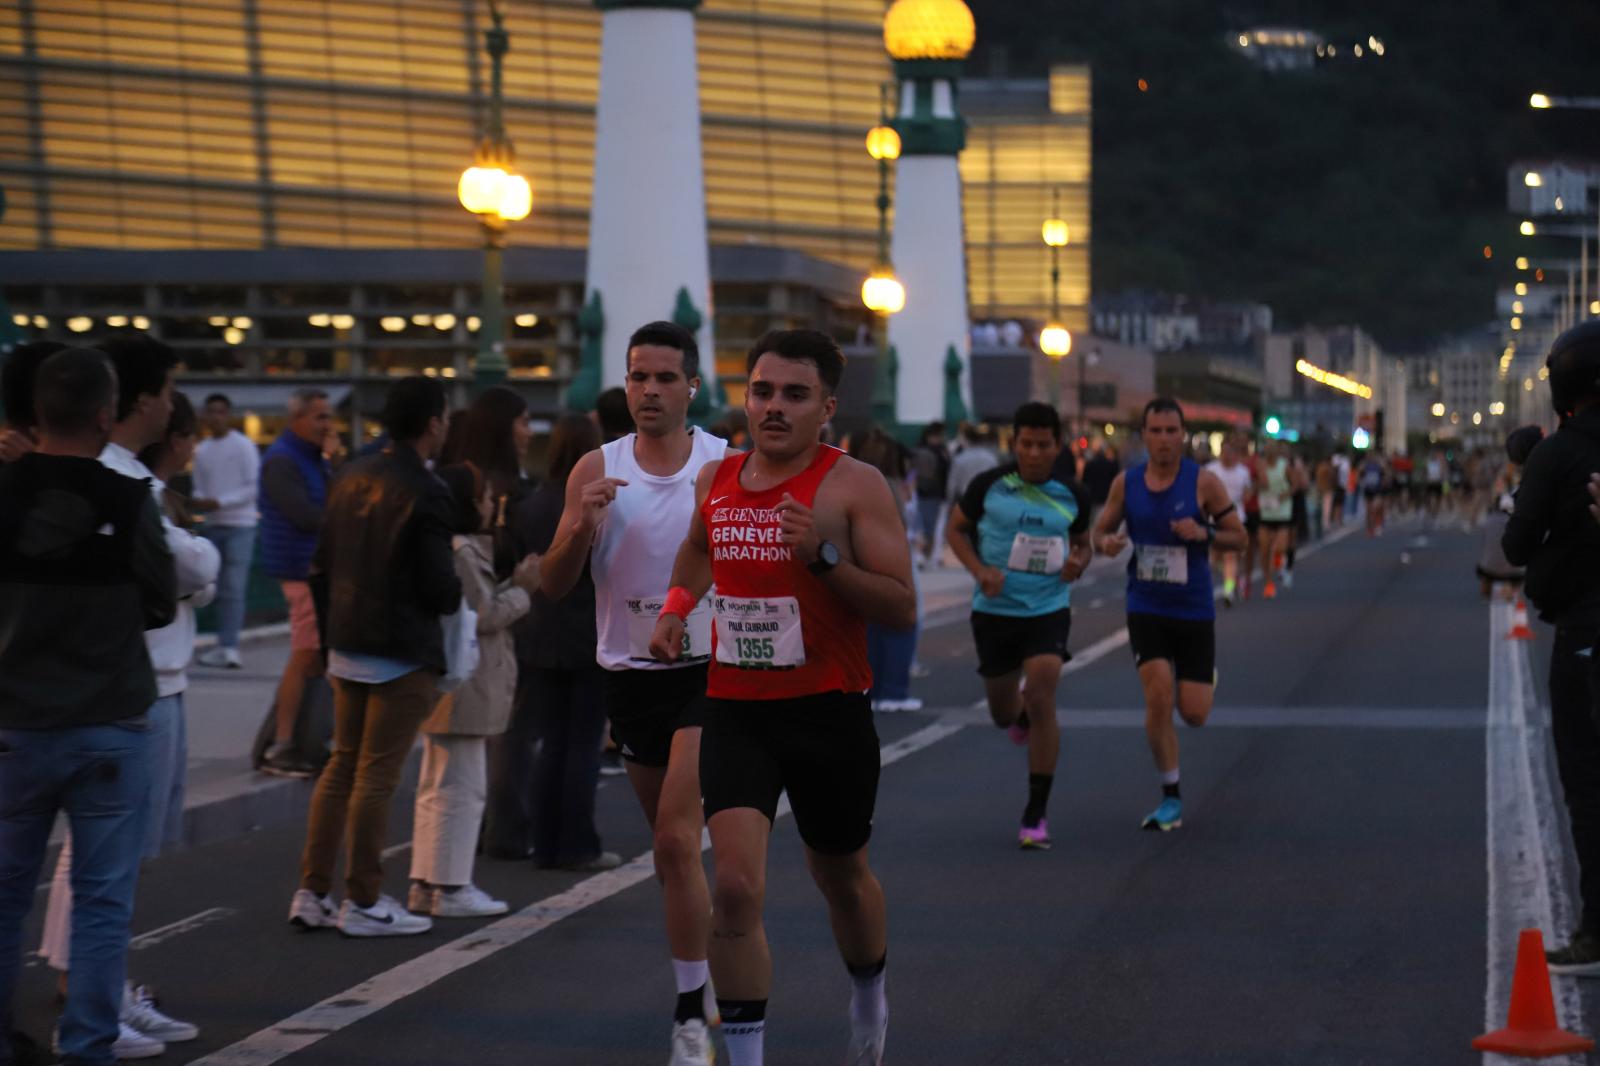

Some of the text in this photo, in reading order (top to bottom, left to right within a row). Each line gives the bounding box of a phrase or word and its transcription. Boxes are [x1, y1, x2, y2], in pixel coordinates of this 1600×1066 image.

[713, 546, 792, 561] MARATHON
[728, 621, 779, 633] PAUL GUIRAUD
[735, 637, 775, 659] 1355
